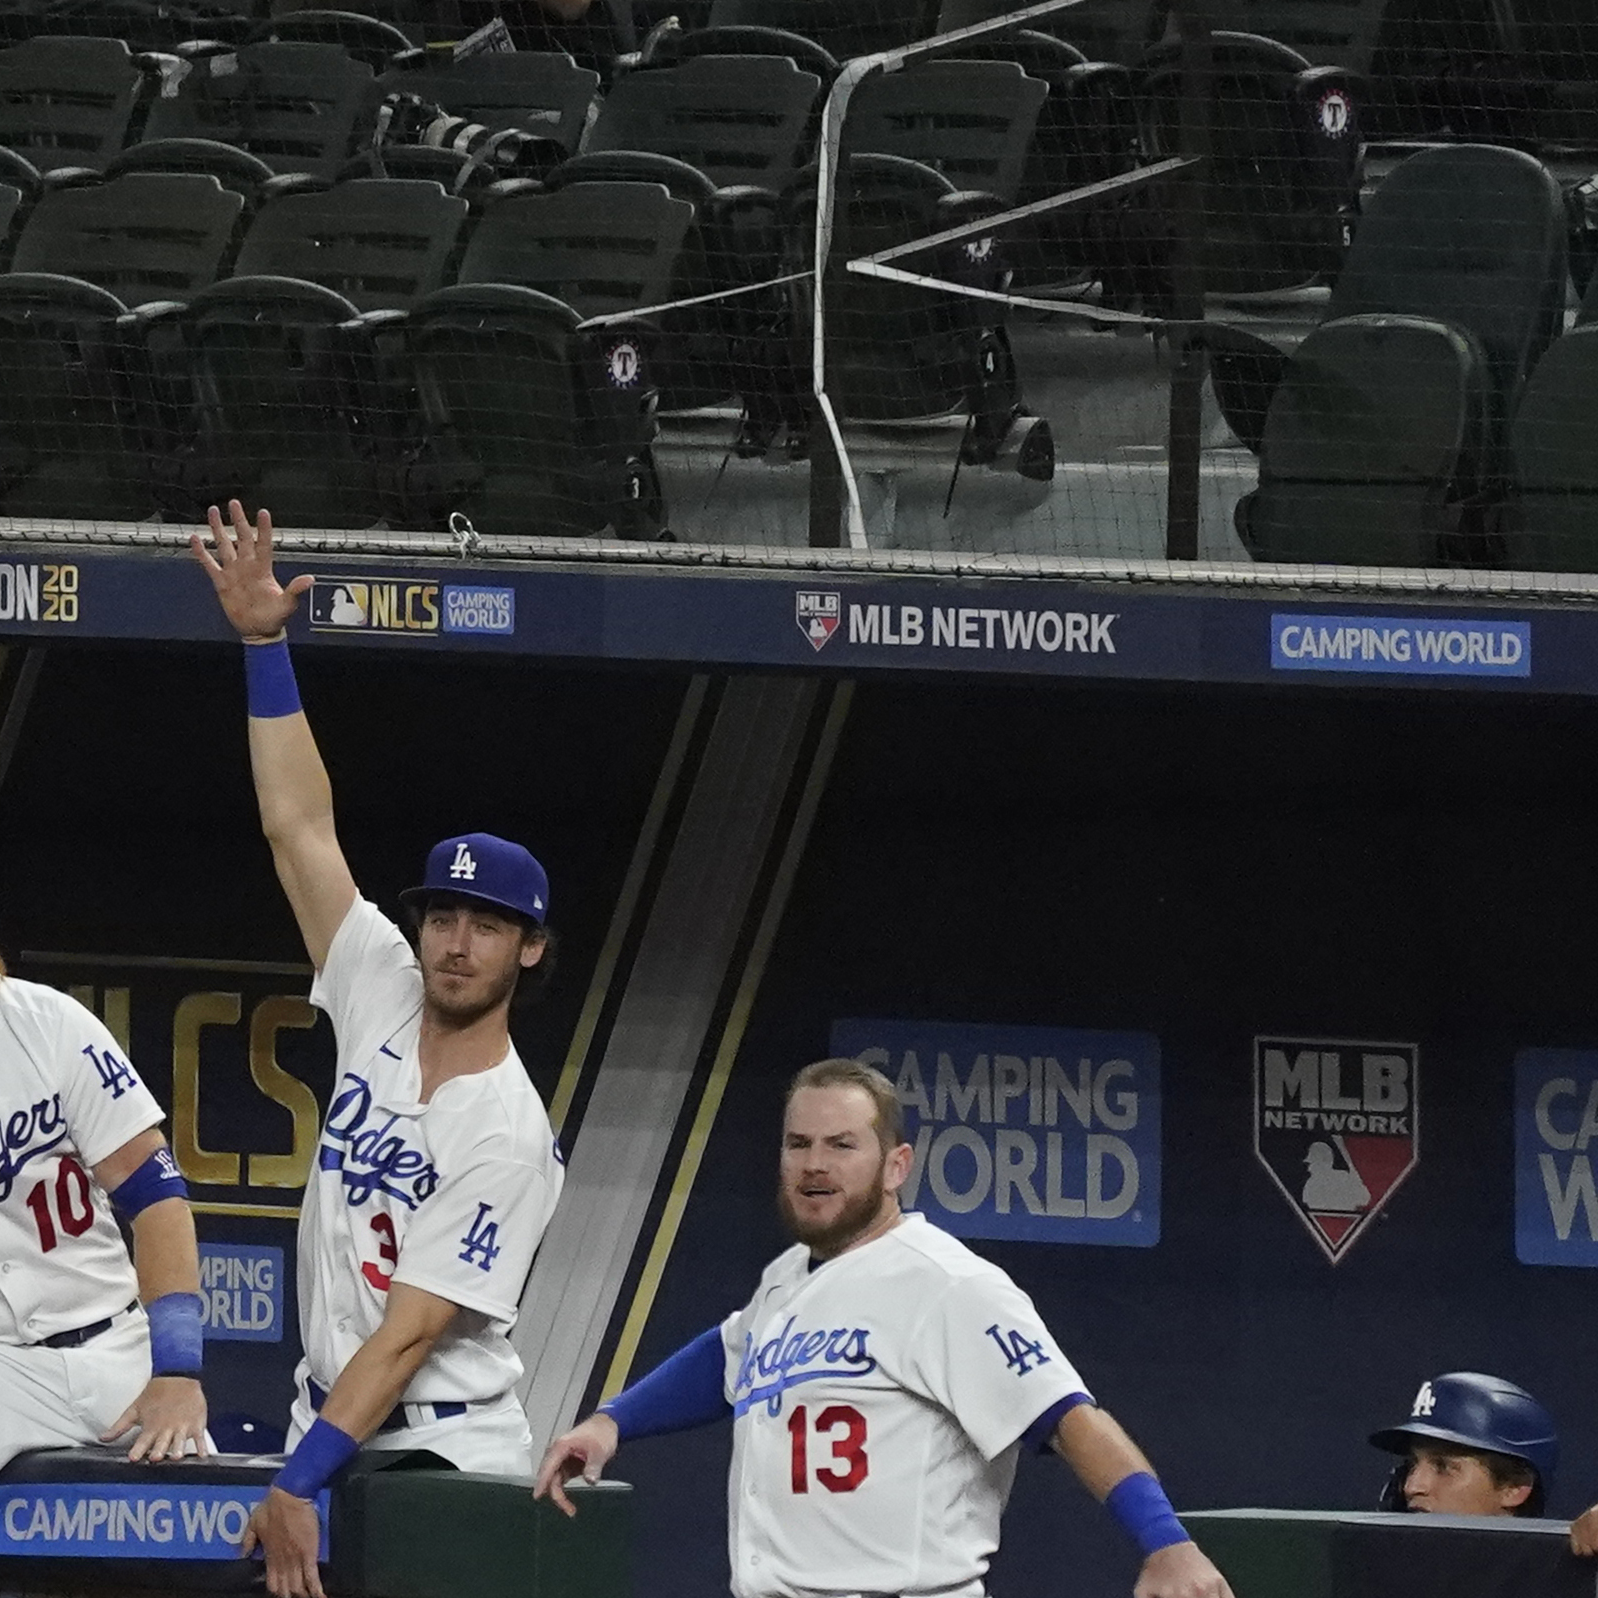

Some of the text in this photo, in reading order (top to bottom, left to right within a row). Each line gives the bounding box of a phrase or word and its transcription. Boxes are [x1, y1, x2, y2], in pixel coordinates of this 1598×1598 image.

[43, 565, 79, 593] 20
[447, 591, 510, 610] CAMPING
[43, 594, 79, 623] 20
[372, 584, 439, 630] NLCS
[449, 608, 510, 630] WORLD
[800, 594, 838, 611] MLB
[849, 604, 1117, 654] MLB NETWORK
[1279, 624, 1523, 667] CAMPING WORLD
[450, 842, 477, 881] LA
[82, 1044, 138, 1101] LA
[1263, 1050, 1409, 1114] MLB
[1263, 1110, 1410, 1135] NETWORK
[26, 1155, 95, 1254] 10
[361, 1212, 399, 1292] 3
[458, 1202, 501, 1273] LA
[985, 1324, 1051, 1377] LA
[787, 1404, 869, 1494] 13
[4, 1497, 176, 1544] CAMPING
